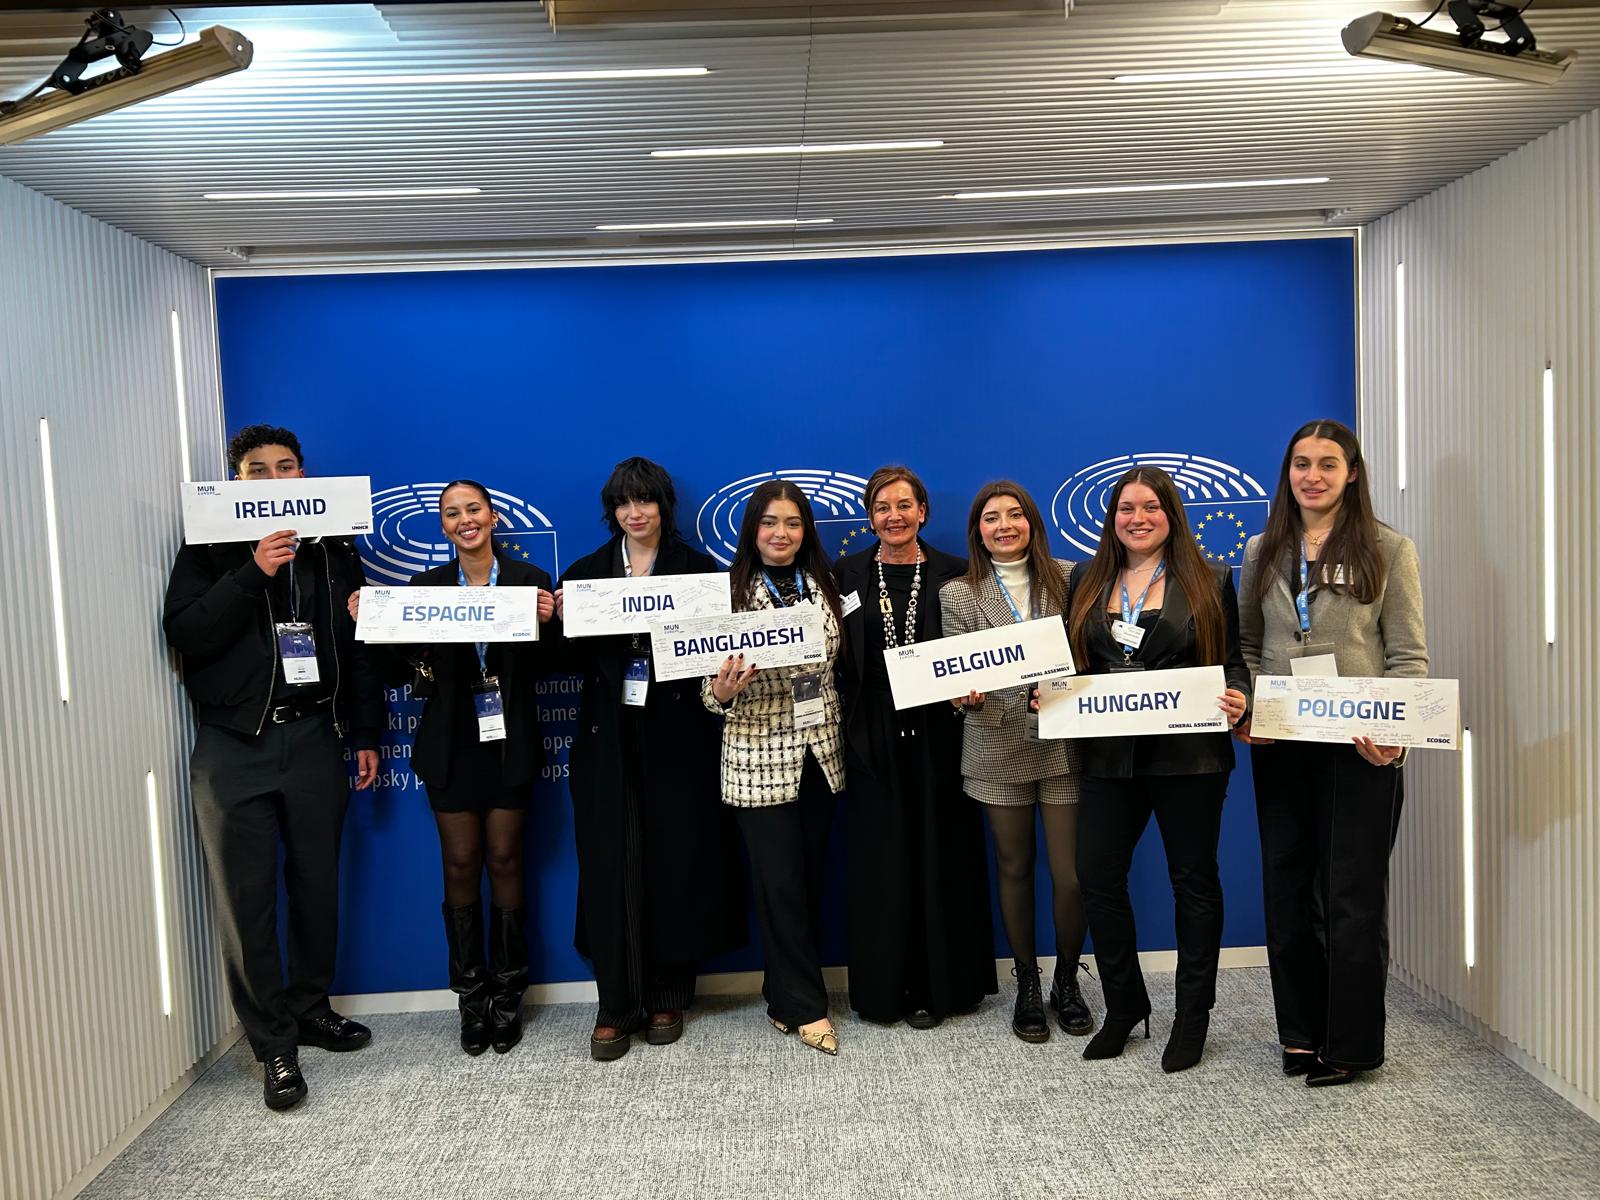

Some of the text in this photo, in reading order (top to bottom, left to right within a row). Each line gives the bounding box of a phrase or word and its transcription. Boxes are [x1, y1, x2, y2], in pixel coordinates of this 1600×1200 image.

[235, 498, 327, 519] IRELAND
[402, 605, 496, 622] ESPAGNE
[622, 594, 675, 613] INDIA
[663, 623, 680, 631] MUN
[673, 626, 805, 657] BANGLADESH
[898, 648, 915, 656] MUN
[932, 644, 1026, 678] BELGIUM
[1020, 666, 1070, 680] GENERAL ASSEMBLY
[1270, 679, 1287, 687] MUN
[1078, 691, 1182, 714] HUNGARY
[1297, 698, 1406, 721] POLOGNE
[388, 711, 423, 734] ki p
[536, 704, 578, 723] lame
[543, 735, 574, 755] ope
[541, 763, 570, 783] ops
